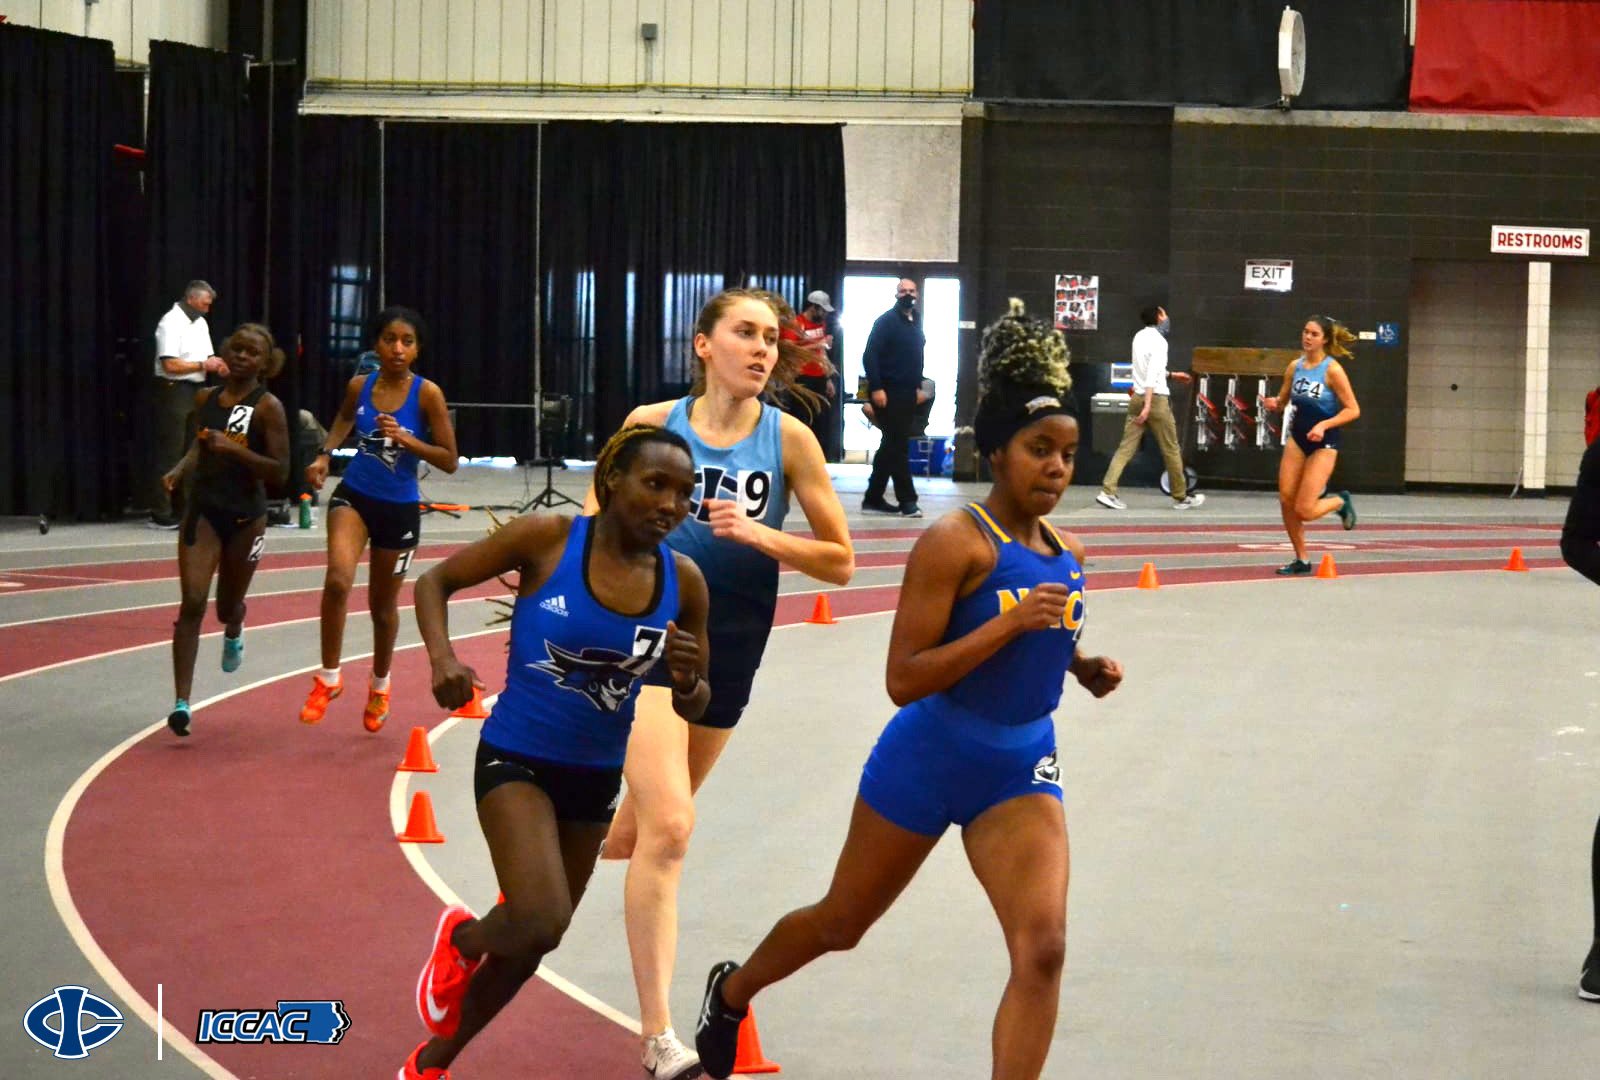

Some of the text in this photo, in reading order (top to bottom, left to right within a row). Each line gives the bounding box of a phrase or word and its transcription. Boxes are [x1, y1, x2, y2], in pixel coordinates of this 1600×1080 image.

[1497, 231, 1583, 249] RESTROOMS
[1252, 266, 1285, 279] EXIT
[1310, 383, 1321, 399] 4
[229, 406, 247, 432] 2
[745, 470, 770, 518] 9
[539, 601, 569, 617] adidas
